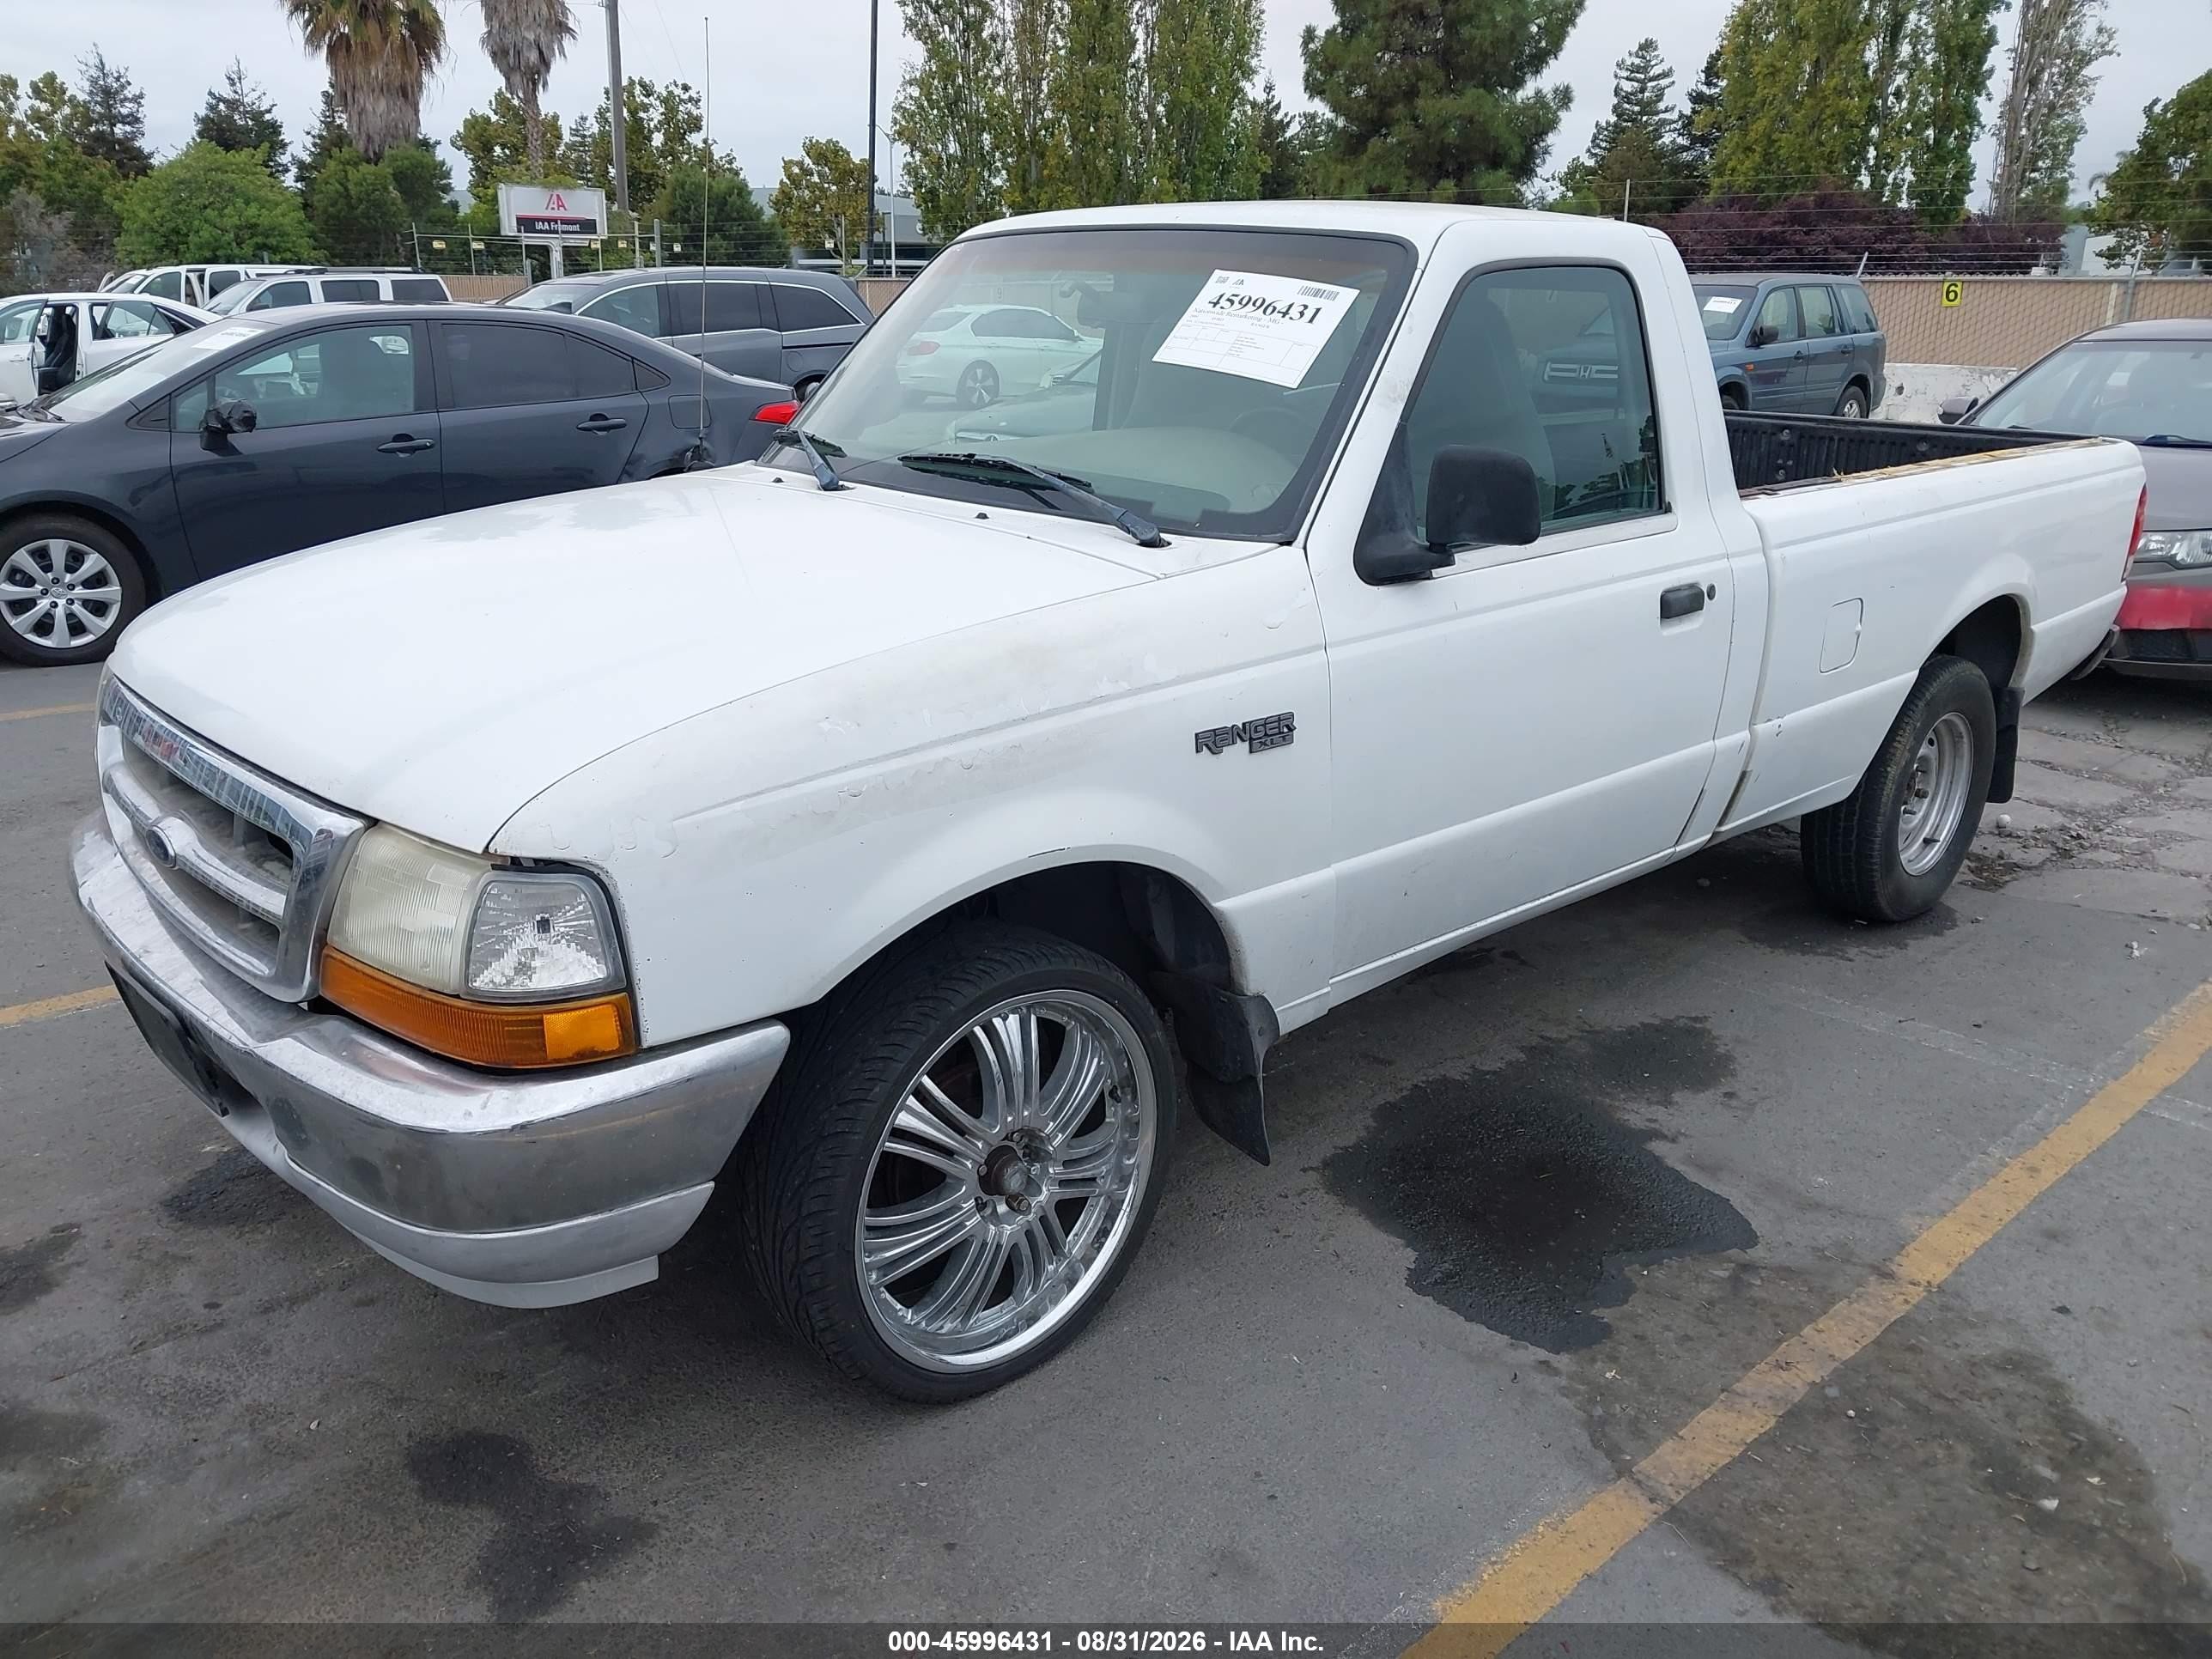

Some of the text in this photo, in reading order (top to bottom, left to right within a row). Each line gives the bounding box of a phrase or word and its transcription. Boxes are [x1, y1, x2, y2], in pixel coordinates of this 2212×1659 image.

[535, 221, 550, 230] IAA
[1945, 283, 1959, 302] 6
[1208, 292, 1323, 325] 45996431
[1194, 711, 1297, 755] RANGER
